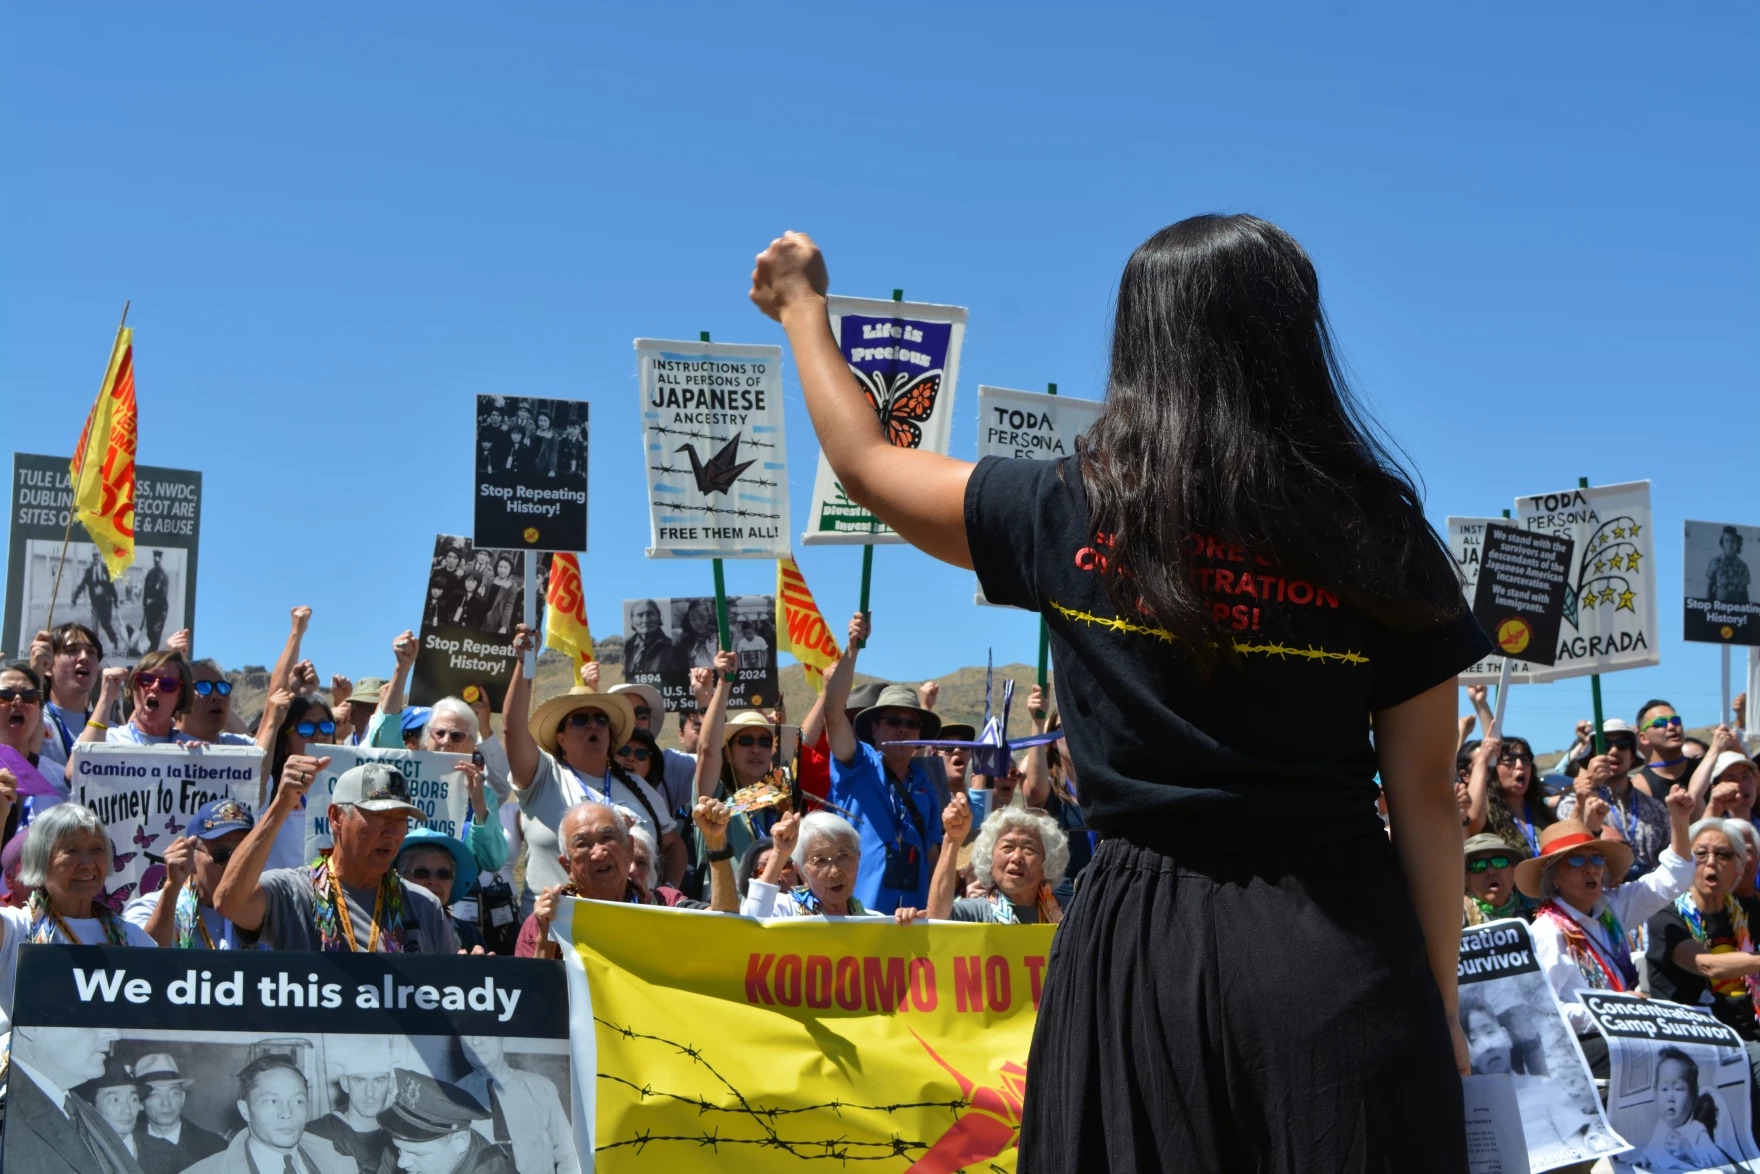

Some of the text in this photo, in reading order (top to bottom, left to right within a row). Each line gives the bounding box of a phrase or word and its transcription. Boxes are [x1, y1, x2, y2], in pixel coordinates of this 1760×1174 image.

[862, 323, 923, 343] Life is
[653, 359, 766, 374] INSTRUCTIONS TO
[851, 348, 931, 368] Precious
[658, 373, 761, 387] ALL PERSONS OF
[652, 388, 766, 410] JAPANESE
[674, 413, 748, 425] ANCESTRY
[994, 406, 1054, 431] TODA
[988, 428, 1065, 455] PERSONA
[19, 469, 197, 501] TULE LA SS, NWDC,
[481, 484, 585, 504] Stop Repeating
[19, 488, 73, 508] DUBLIN
[171, 502, 196, 518] ARE
[506, 501, 561, 517] History!
[823, 505, 861, 516] Divest
[1529, 490, 1587, 512] TODA
[19, 508, 56, 526] SITES
[143, 517, 152, 532] &
[154, 520, 193, 535] ABUSE
[834, 519, 872, 531] Invest
[1527, 510, 1600, 532] PERSONA
[660, 526, 779, 540] FREE THEM ALL!
[1493, 529, 1507, 540] We
[1508, 533, 1532, 545] stand
[1533, 538, 1551, 550] with
[1552, 542, 1566, 553] the
[1186, 532, 1247, 563] ORE
[1500, 543, 1556, 561] survivors and
[1488, 548, 1539, 568] descendants
[1541, 559, 1550, 570] of
[1551, 562, 1565, 573] the
[1075, 547, 1340, 609] COTRATION
[1485, 559, 1525, 575] Japanese
[1525, 567, 1563, 583] American
[1496, 571, 1551, 590] incarceration.
[1492, 583, 1550, 605] We stand with
[1495, 594, 1545, 613] immigrants.
[1687, 598, 1760, 617] Stop Repeatin
[1706, 612, 1747, 627] History!
[426, 635, 518, 657] Stop Repeati
[1558, 630, 1648, 661] AGRADA
[450, 655, 506, 675] History!
[1487, 662, 1518, 672] THM
[634, 670, 767, 684] 1894 2024
[663, 686, 687, 697] U.S.
[732, 683, 745, 694] of
[664, 698, 678, 710] ily
[79, 760, 147, 778] Camino
[151, 768, 161, 777] a
[167, 765, 182, 778] la
[157, 778, 173, 814] to
[408, 779, 449, 799] BORS
[408, 819, 456, 838] ECINOS
[1459, 928, 1519, 952] ration
[745, 953, 1045, 1013] KODOMO NO T
[73, 967, 522, 1022] We did this already
[1601, 1014, 1733, 1040] Camp Survivor
